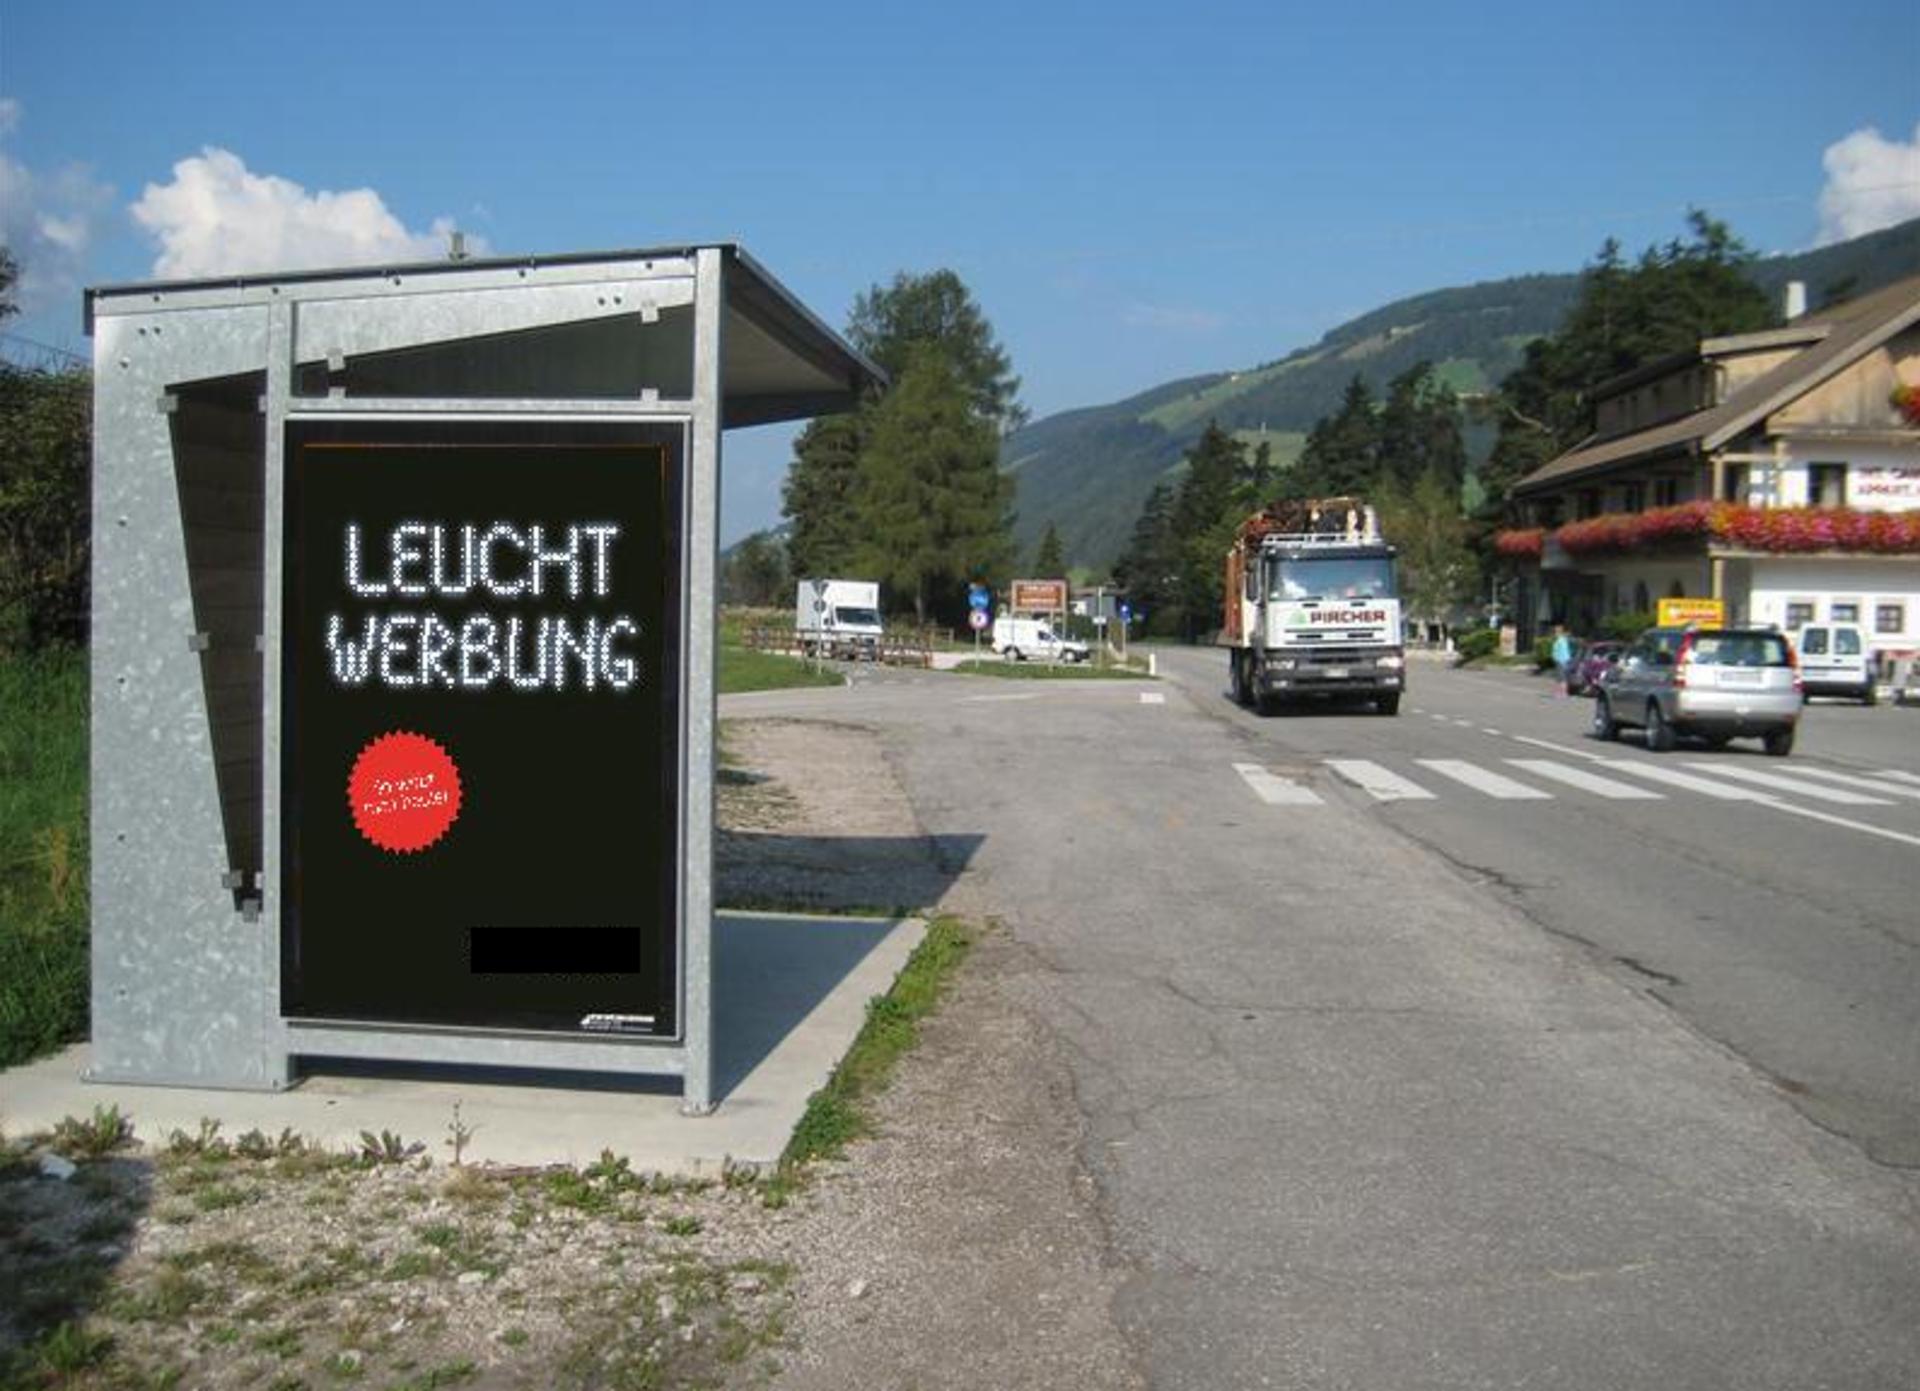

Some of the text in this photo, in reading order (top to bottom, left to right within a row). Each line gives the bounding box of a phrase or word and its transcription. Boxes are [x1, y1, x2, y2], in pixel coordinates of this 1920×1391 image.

[343, 519, 620, 600] LEUCHT
[325, 611, 640, 692] WERBUNG
[1310, 610, 1386, 624] PIRCHER
